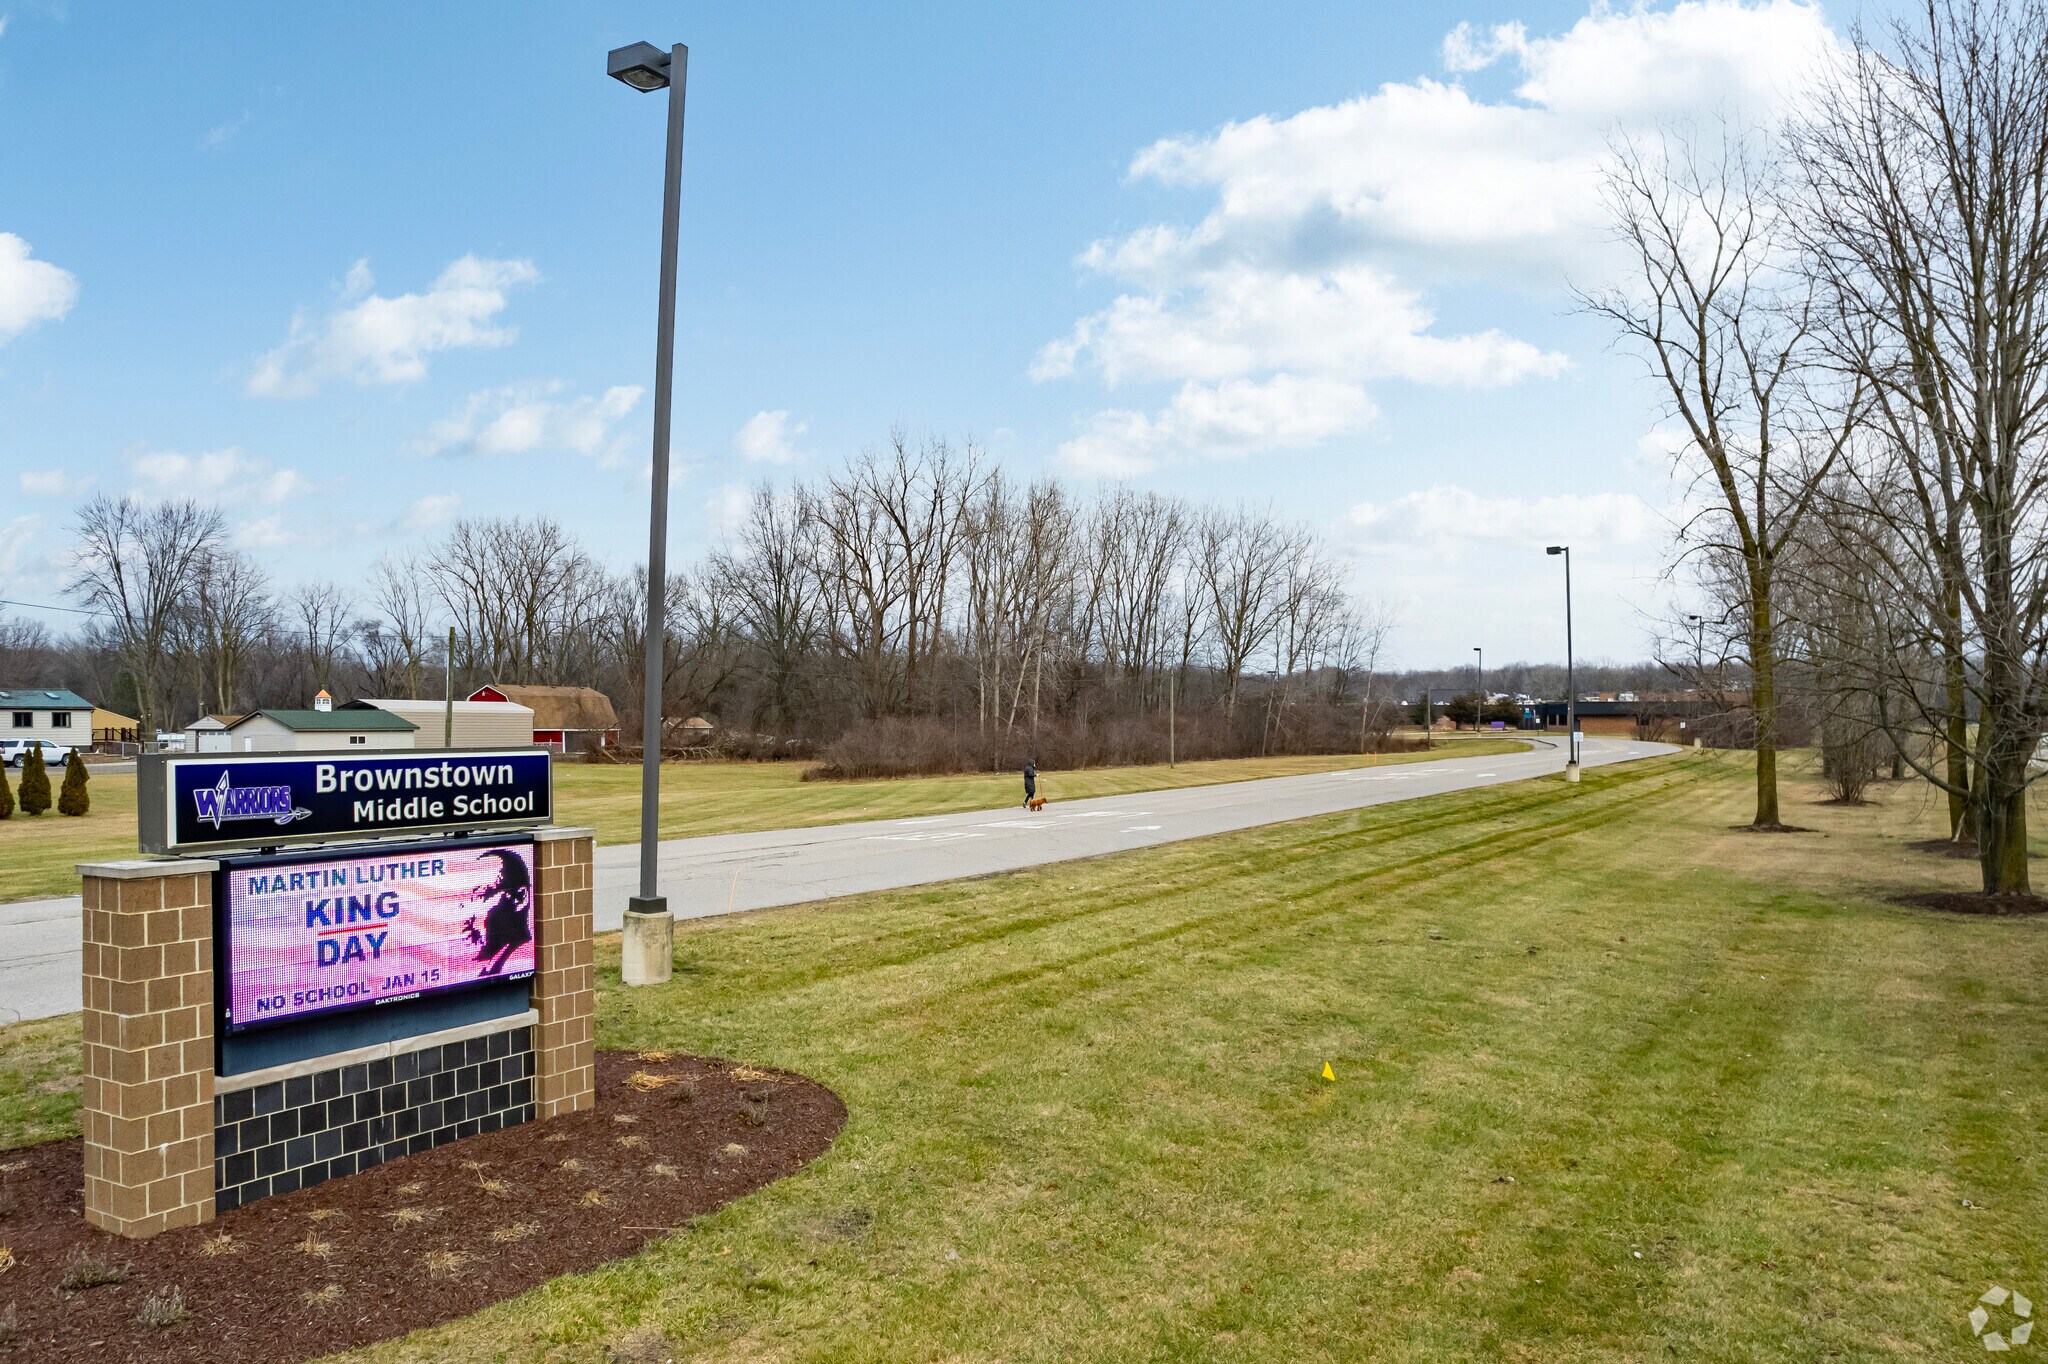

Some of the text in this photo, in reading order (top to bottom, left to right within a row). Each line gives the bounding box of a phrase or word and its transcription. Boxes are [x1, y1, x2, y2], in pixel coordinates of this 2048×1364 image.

[316, 762, 514, 794] Brownstown
[193, 785, 292, 819] WARRIORS
[353, 791, 534, 823] Middle School
[249, 859, 445, 896] MARTIN LUTHER
[305, 891, 400, 928] KING
[317, 930, 388, 968] DAY
[256, 968, 440, 1013] NO SCHOOL JAN 15
[375, 992, 420, 1005] DAKTRONICS
